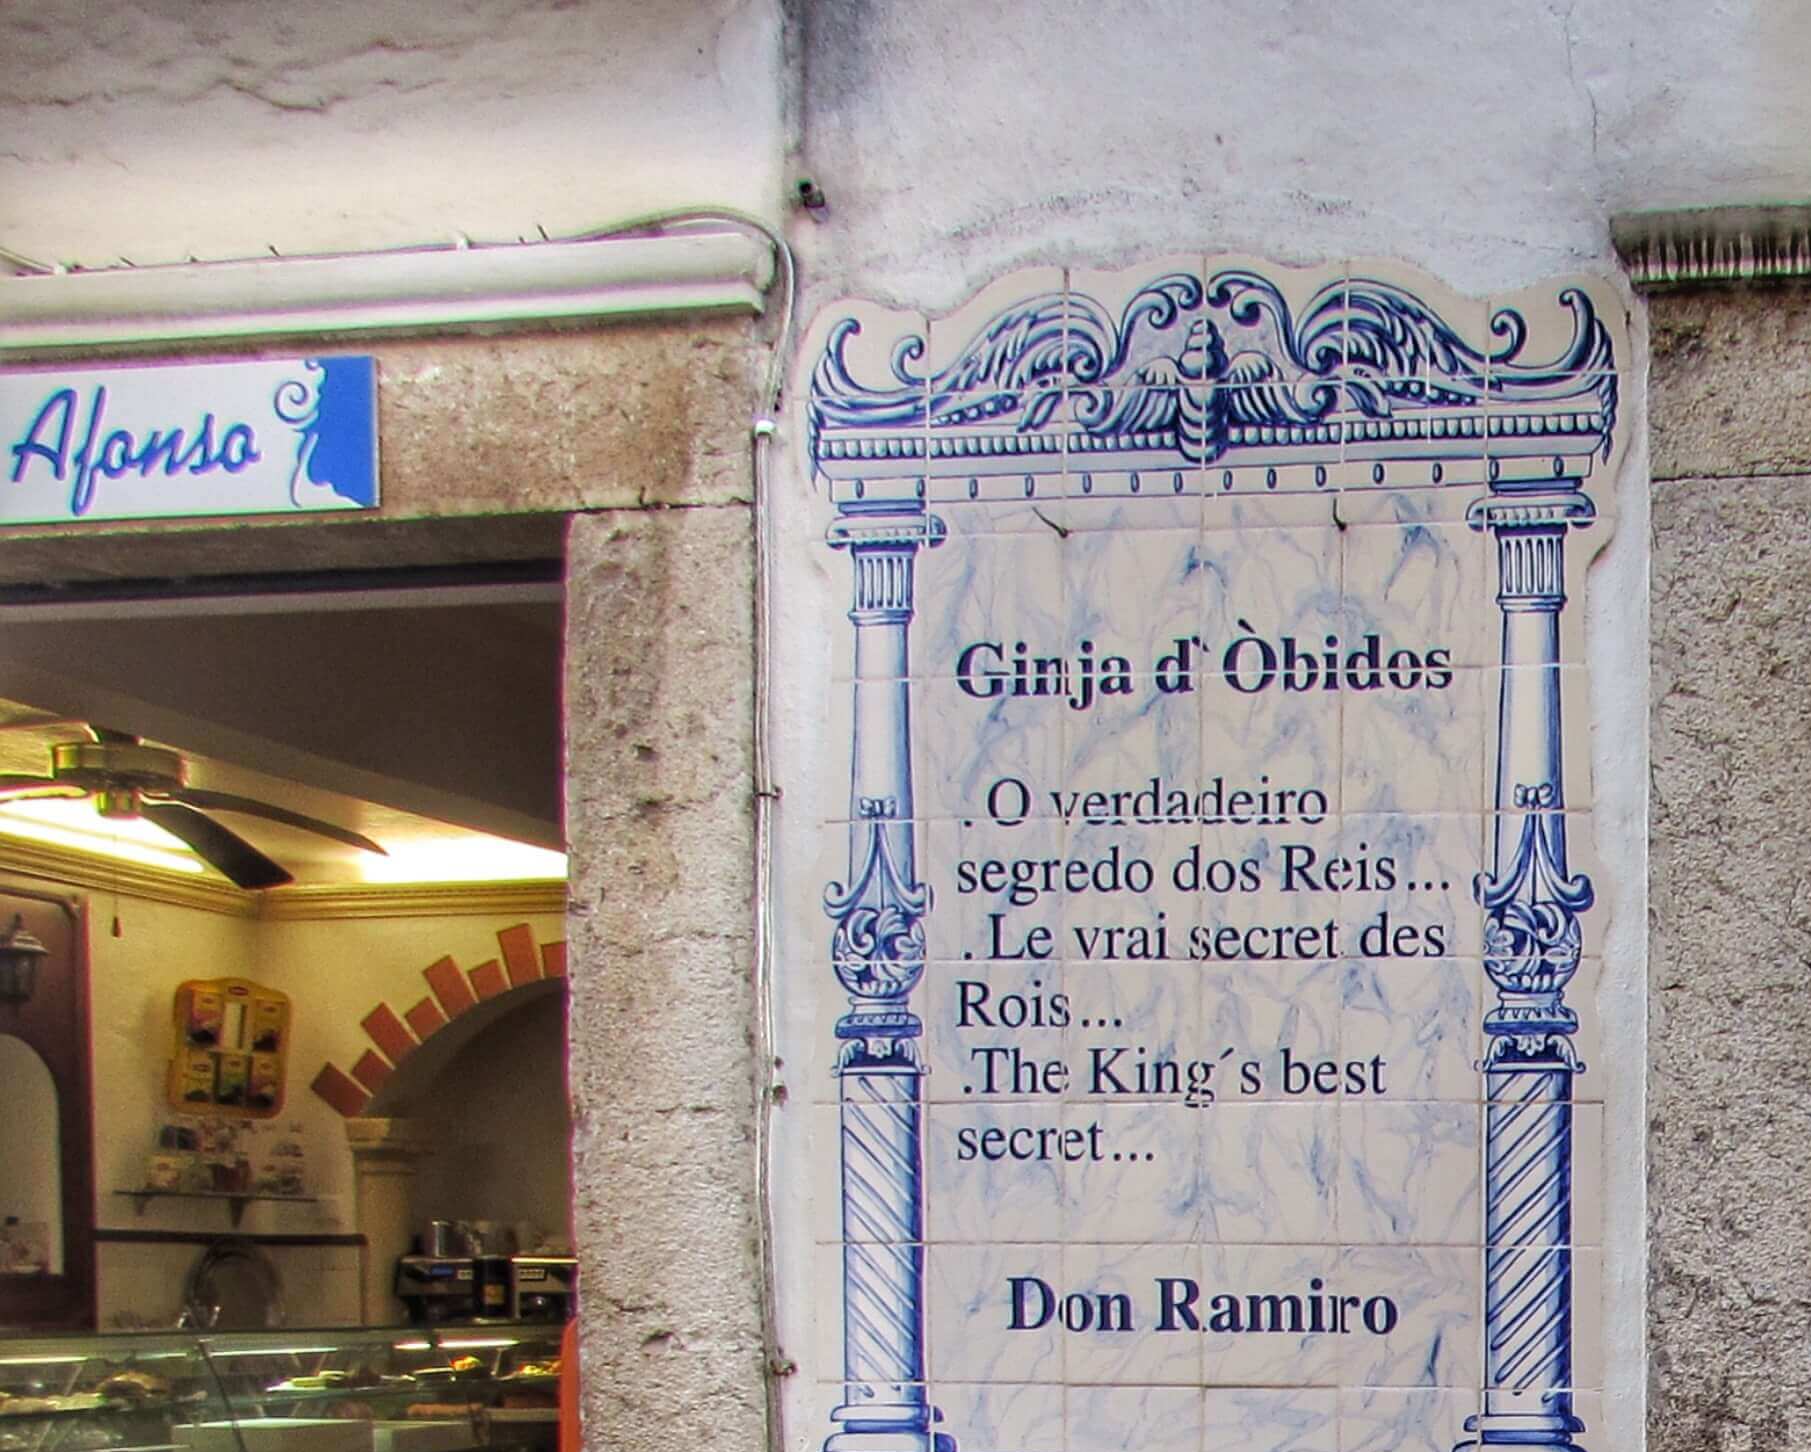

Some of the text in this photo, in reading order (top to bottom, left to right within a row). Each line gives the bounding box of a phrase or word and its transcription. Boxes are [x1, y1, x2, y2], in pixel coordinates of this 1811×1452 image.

[12, 386, 261, 516] Afonso
[956, 641, 1133, 711] Ginja
[1050, 776, 1328, 827] verdadeiro
[957, 843, 1450, 907] segredo dos Reis...
[1074, 911, 1170, 960] vrai
[1189, 920, 1340, 961] secret
[1359, 911, 1446, 958] des
[956, 979, 1122, 1028] Rois...
[1280, 1047, 1387, 1095] best
[957, 1122, 1154, 1161] secret...
[1006, 1277, 1398, 1335] Don Ramiro
